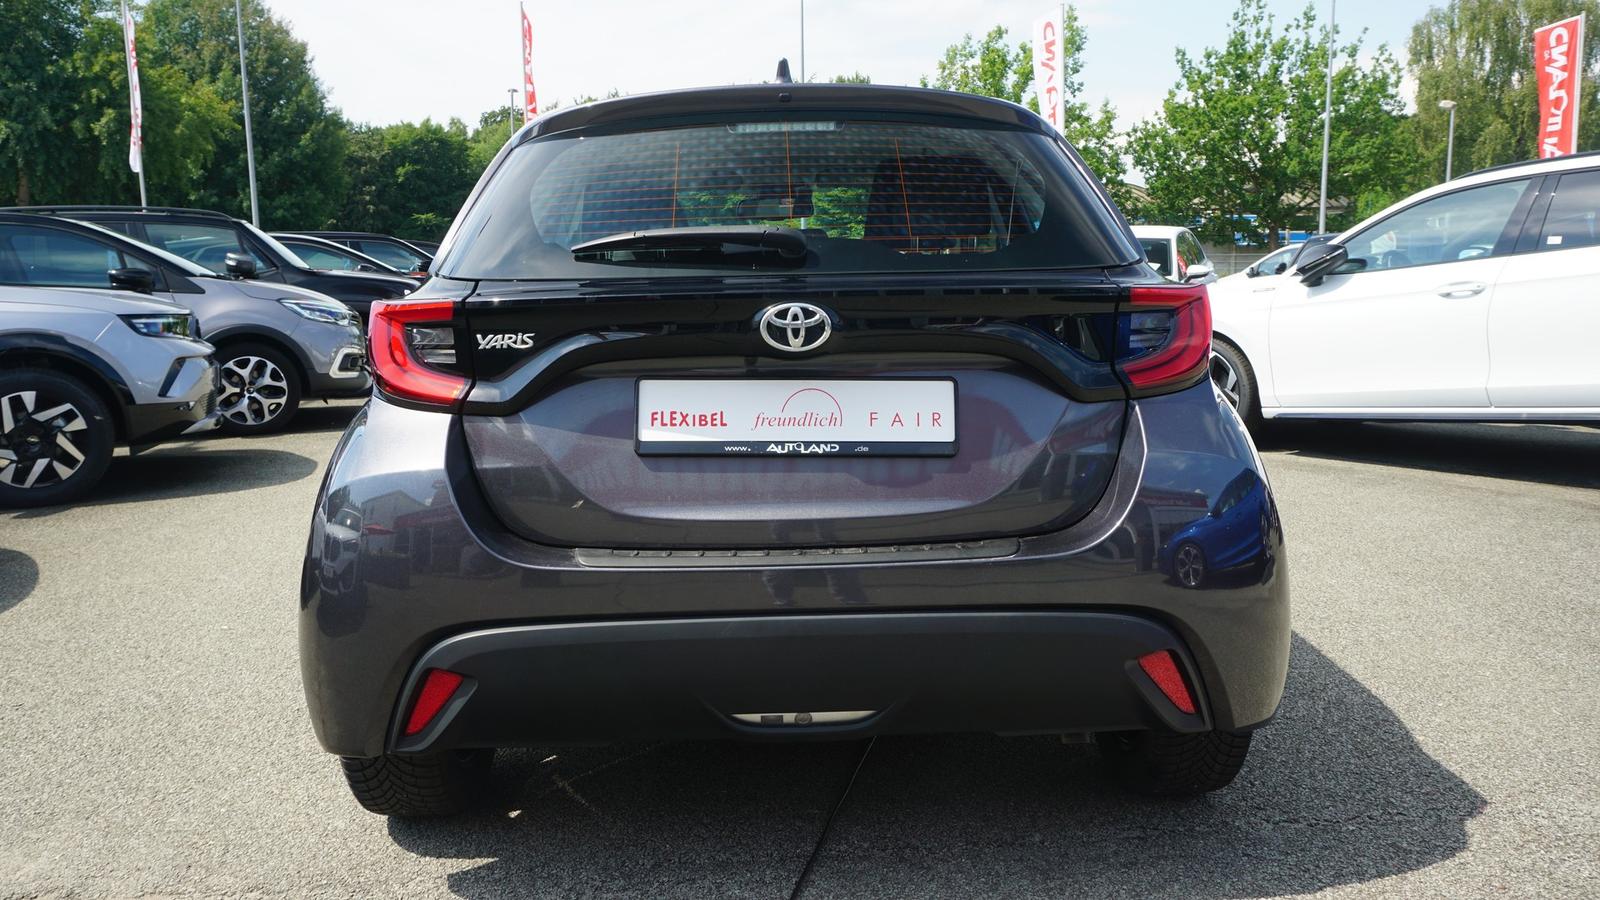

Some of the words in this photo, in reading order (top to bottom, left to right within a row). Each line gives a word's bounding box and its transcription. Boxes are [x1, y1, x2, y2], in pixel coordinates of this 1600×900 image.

[650, 410, 728, 428] FLEXIBEL
[753, 411, 839, 431] freundlich
[868, 411, 943, 428] FAIR
[766, 442, 840, 454] AUTOLAND
